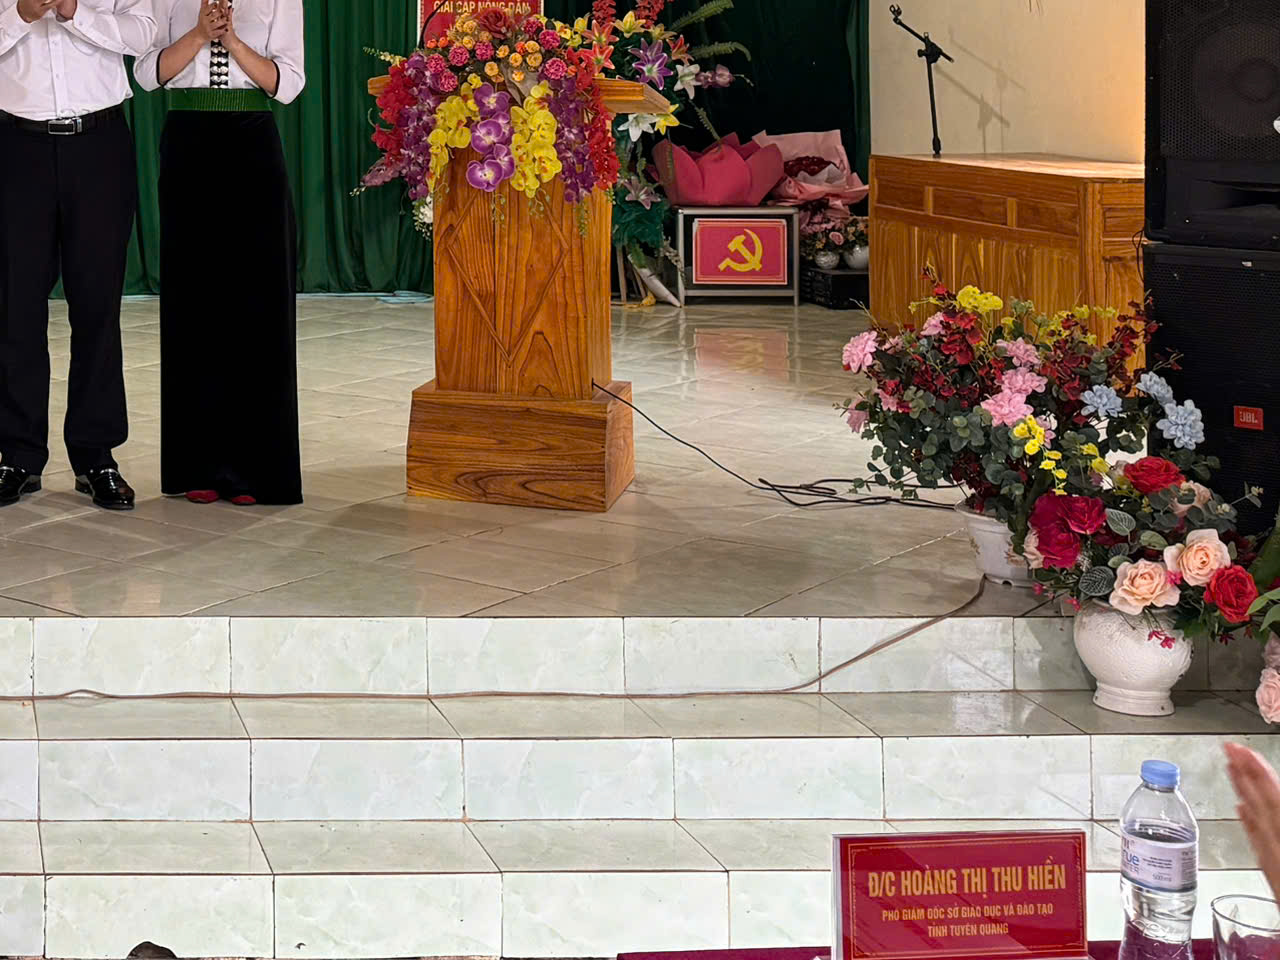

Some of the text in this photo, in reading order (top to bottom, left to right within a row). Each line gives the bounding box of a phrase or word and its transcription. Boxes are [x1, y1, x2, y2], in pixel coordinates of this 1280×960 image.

[1240, 411, 1258, 424] JBL
[868, 856, 1066, 899] Đ/C HOÀNG THỊ THU HIỀN
